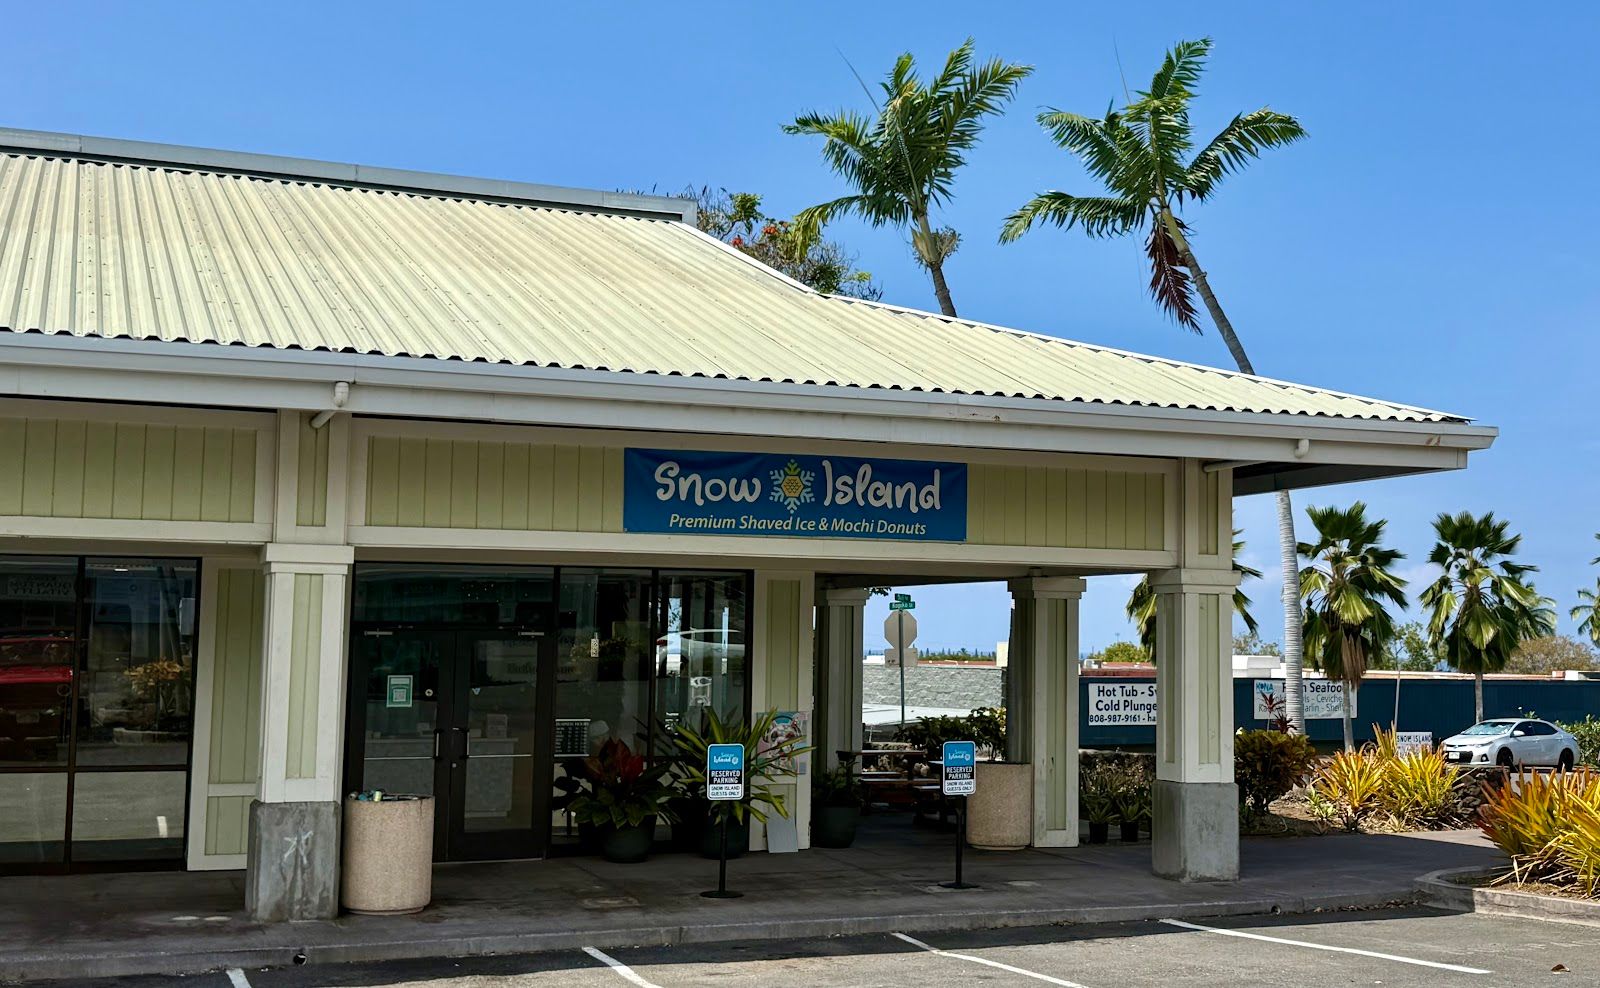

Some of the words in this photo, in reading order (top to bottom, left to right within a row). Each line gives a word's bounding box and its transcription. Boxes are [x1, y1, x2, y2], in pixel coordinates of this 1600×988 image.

[654, 461, 762, 507] Snow
[822, 459, 941, 513] Island
[669, 513, 735, 530] Premium
[739, 515, 793, 531] Shaved
[795, 517, 815, 532] Ice
[818, 520, 829, 531] &
[831, 519, 874, 533] Mochi
[876, 520, 926, 535] Donuts
[1097, 685, 1116, 697] Hot
[1119, 685, 1138, 697] Tub
[1310, 682, 1343, 693] Seafoo
[1095, 699, 1120, 712] Cold
[1123, 699, 1157, 714] Plunge
[1304, 703, 1320, 712] arlin
[1089, 714, 1141, 723] 808-987-9161
